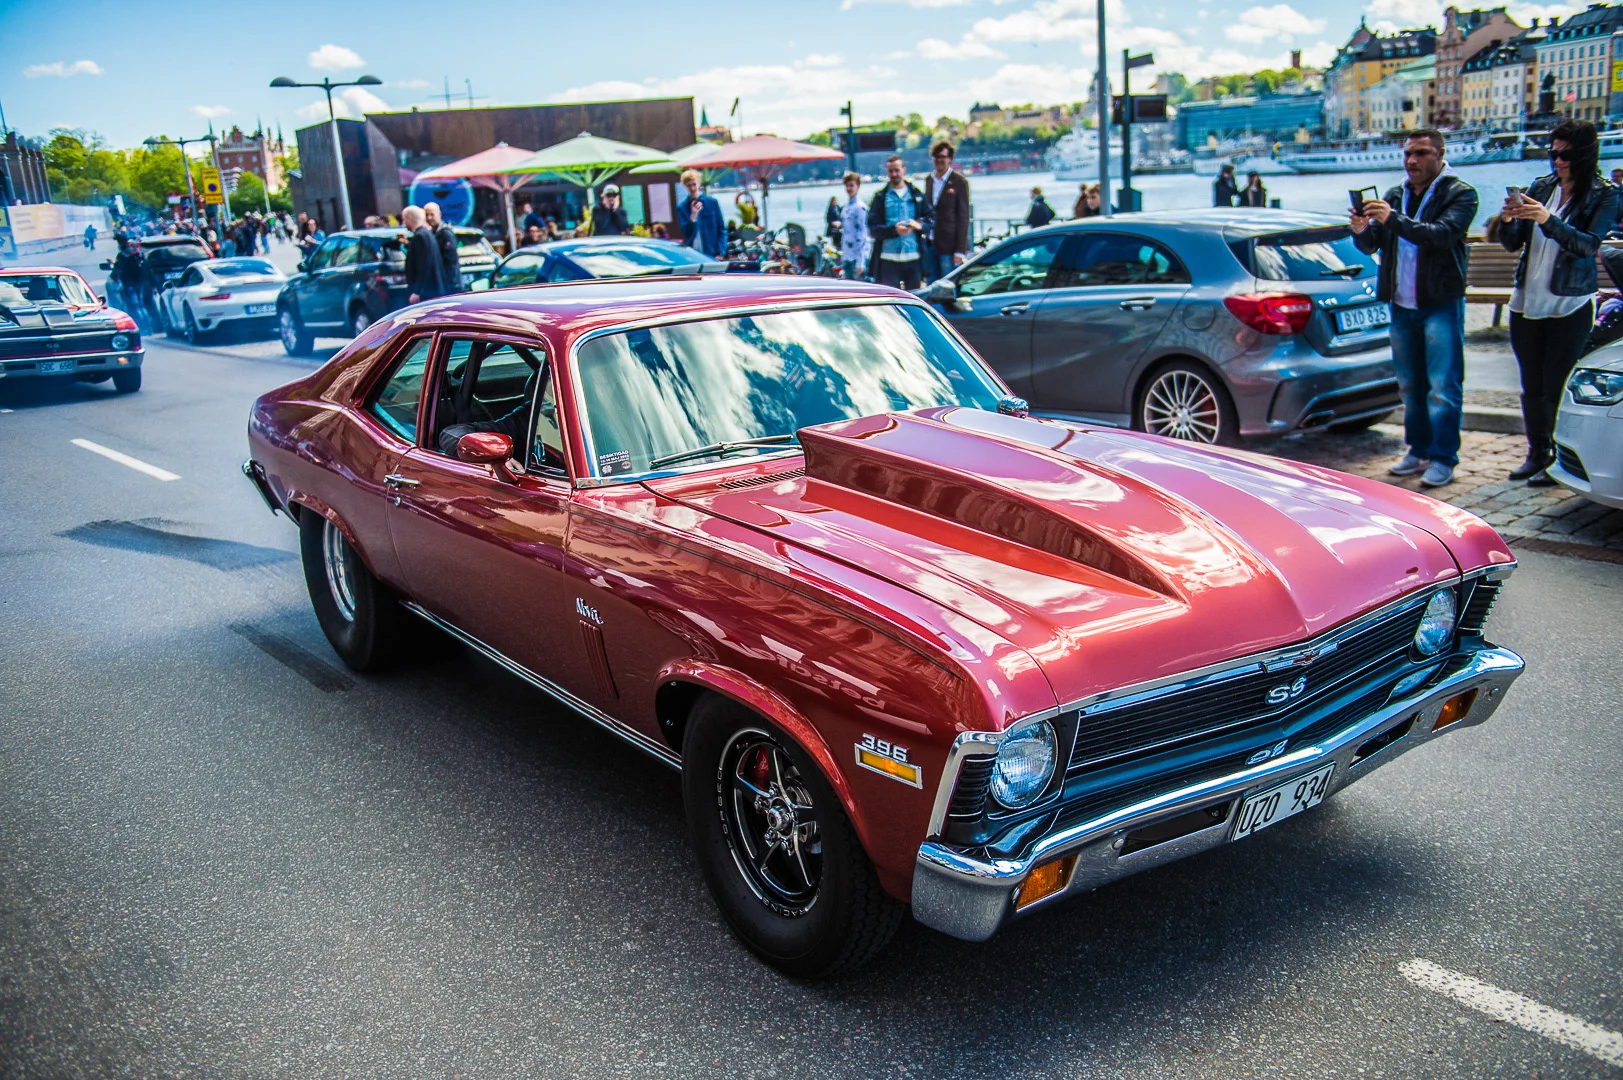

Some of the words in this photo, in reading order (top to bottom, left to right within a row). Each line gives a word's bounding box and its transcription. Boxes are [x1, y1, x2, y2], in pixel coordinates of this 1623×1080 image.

[1344, 310, 1365, 327] BXD
[1367, 305, 1387, 323] 825
[1266, 675, 1307, 704] SS
[861, 732, 908, 762] 396
[1239, 792, 1281, 833] UZO
[1291, 770, 1331, 811] 934
